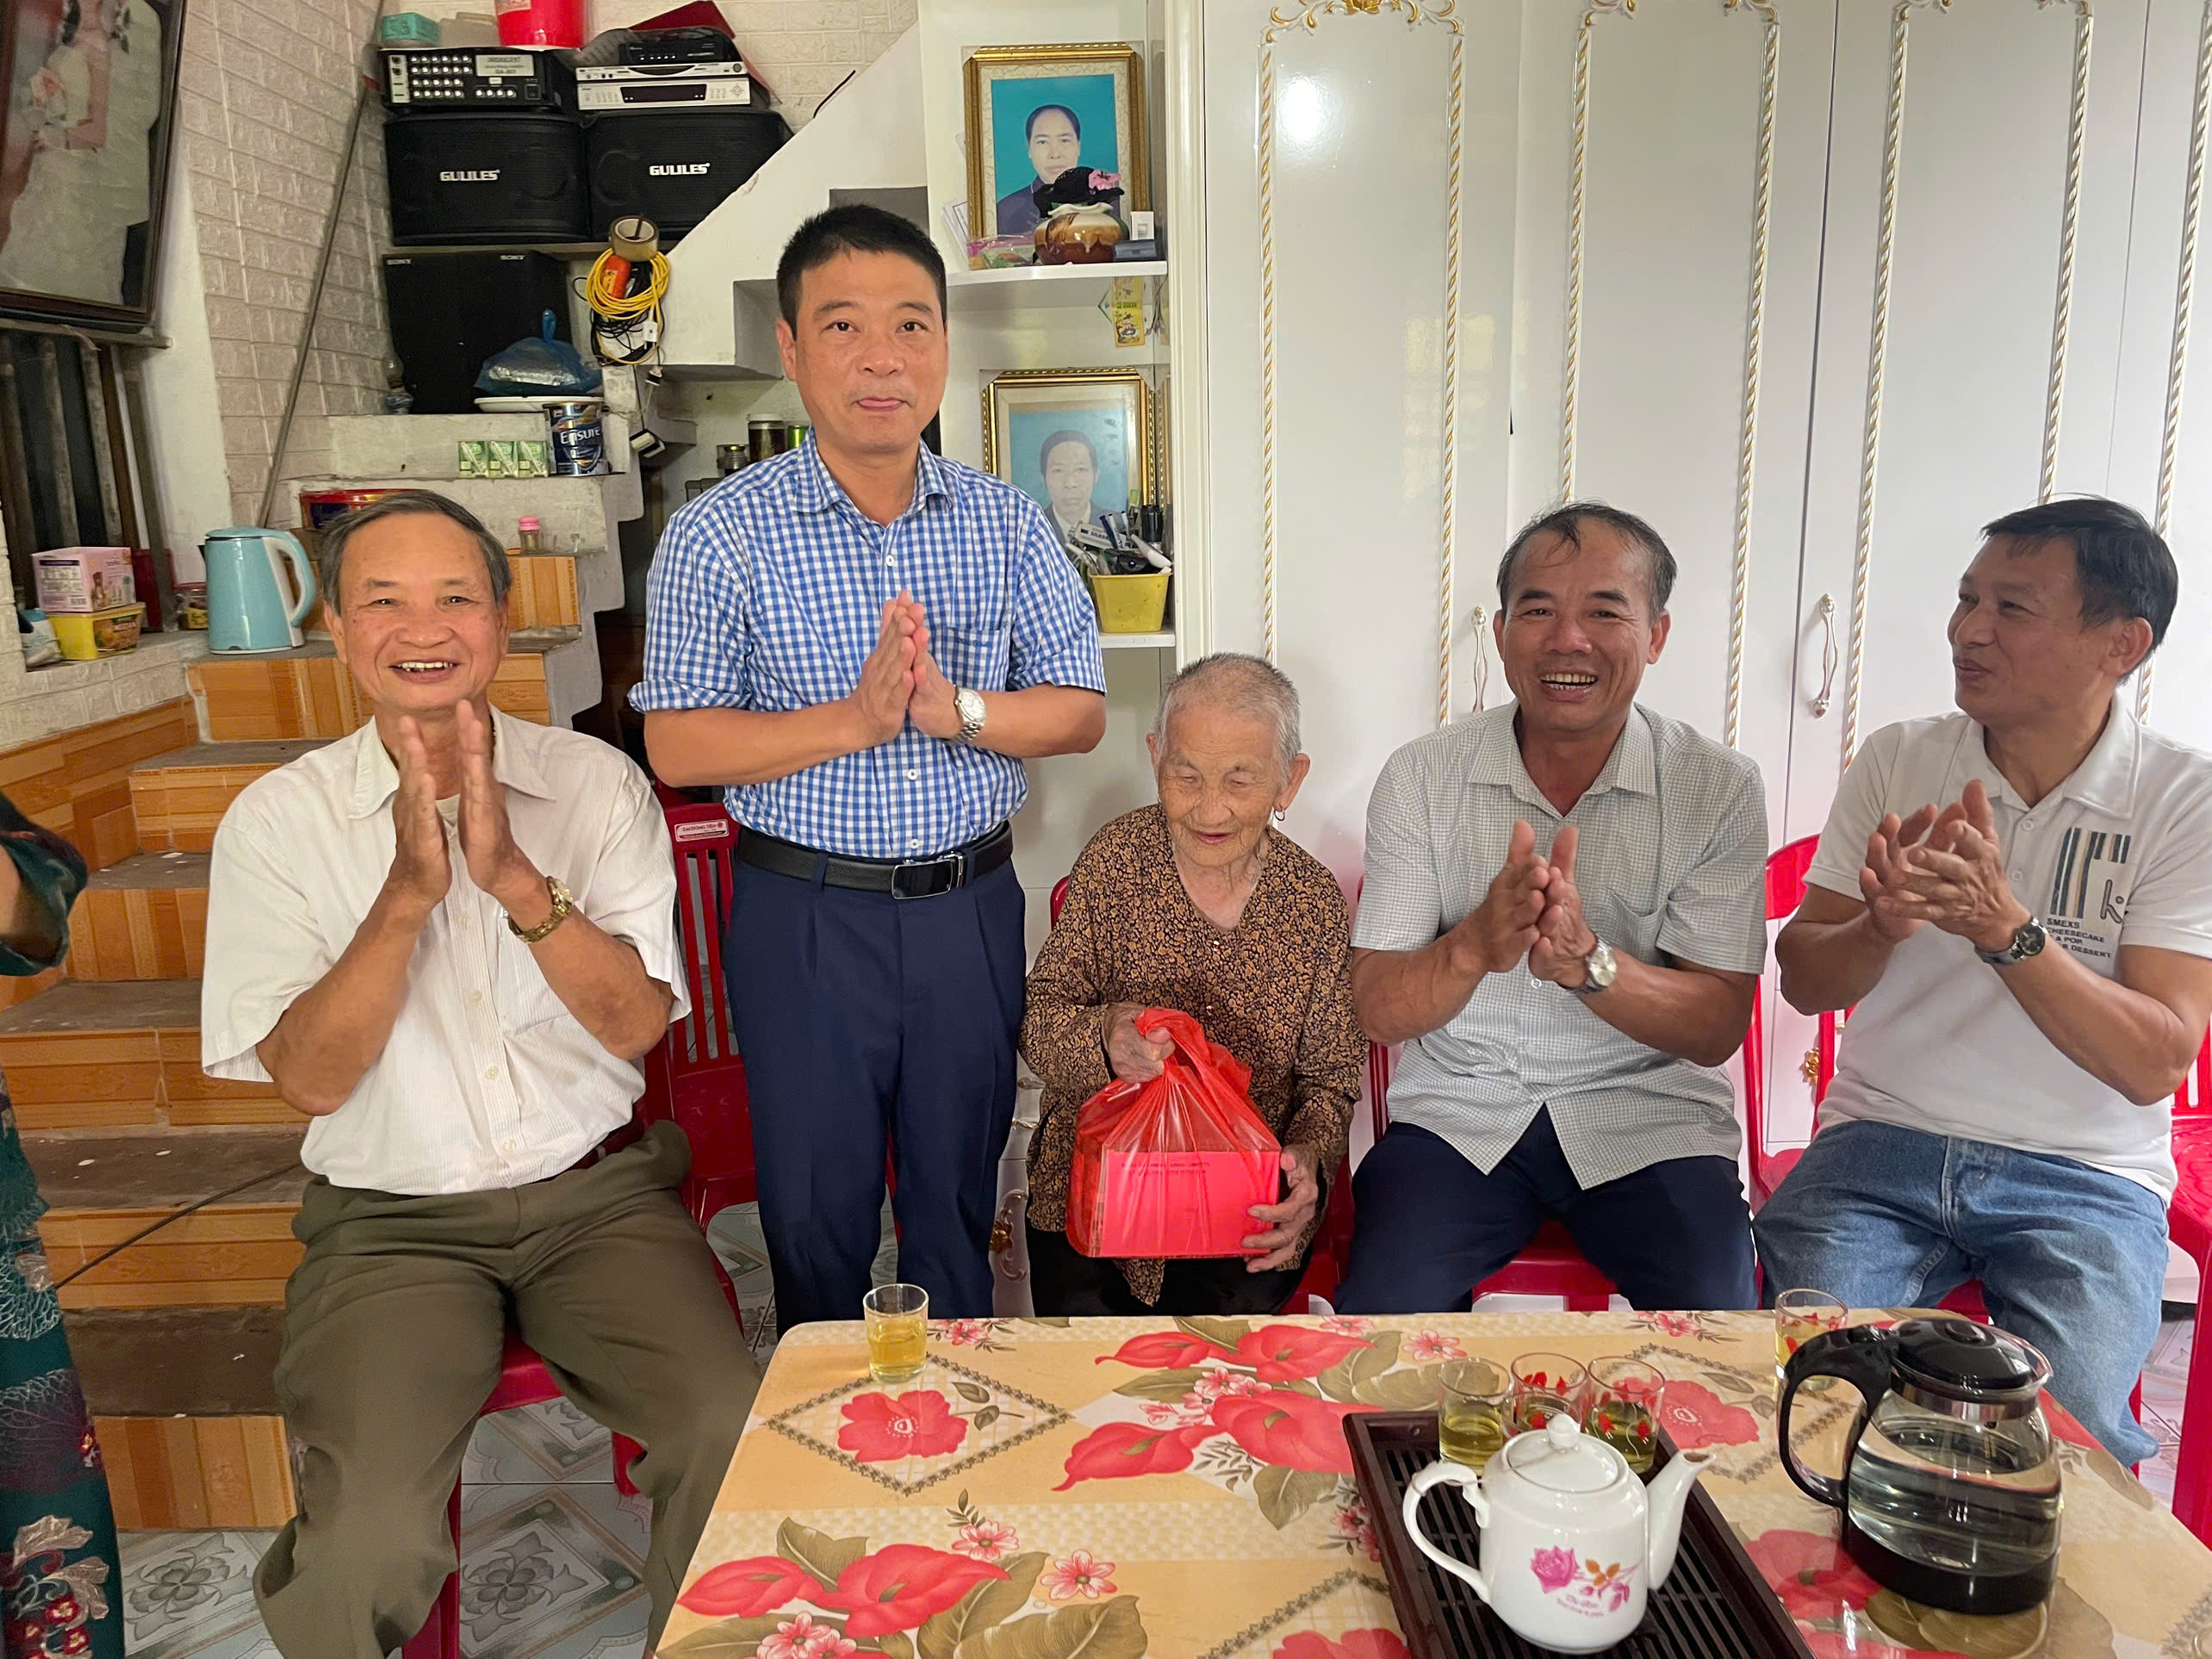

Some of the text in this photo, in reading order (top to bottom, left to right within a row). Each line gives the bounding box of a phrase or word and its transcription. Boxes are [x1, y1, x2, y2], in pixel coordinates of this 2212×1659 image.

[2046, 917, 2080, 929] SMEXS
[2046, 927, 2104, 943] CHEESECAKE
[2071, 944, 2111, 958] DESSERT
